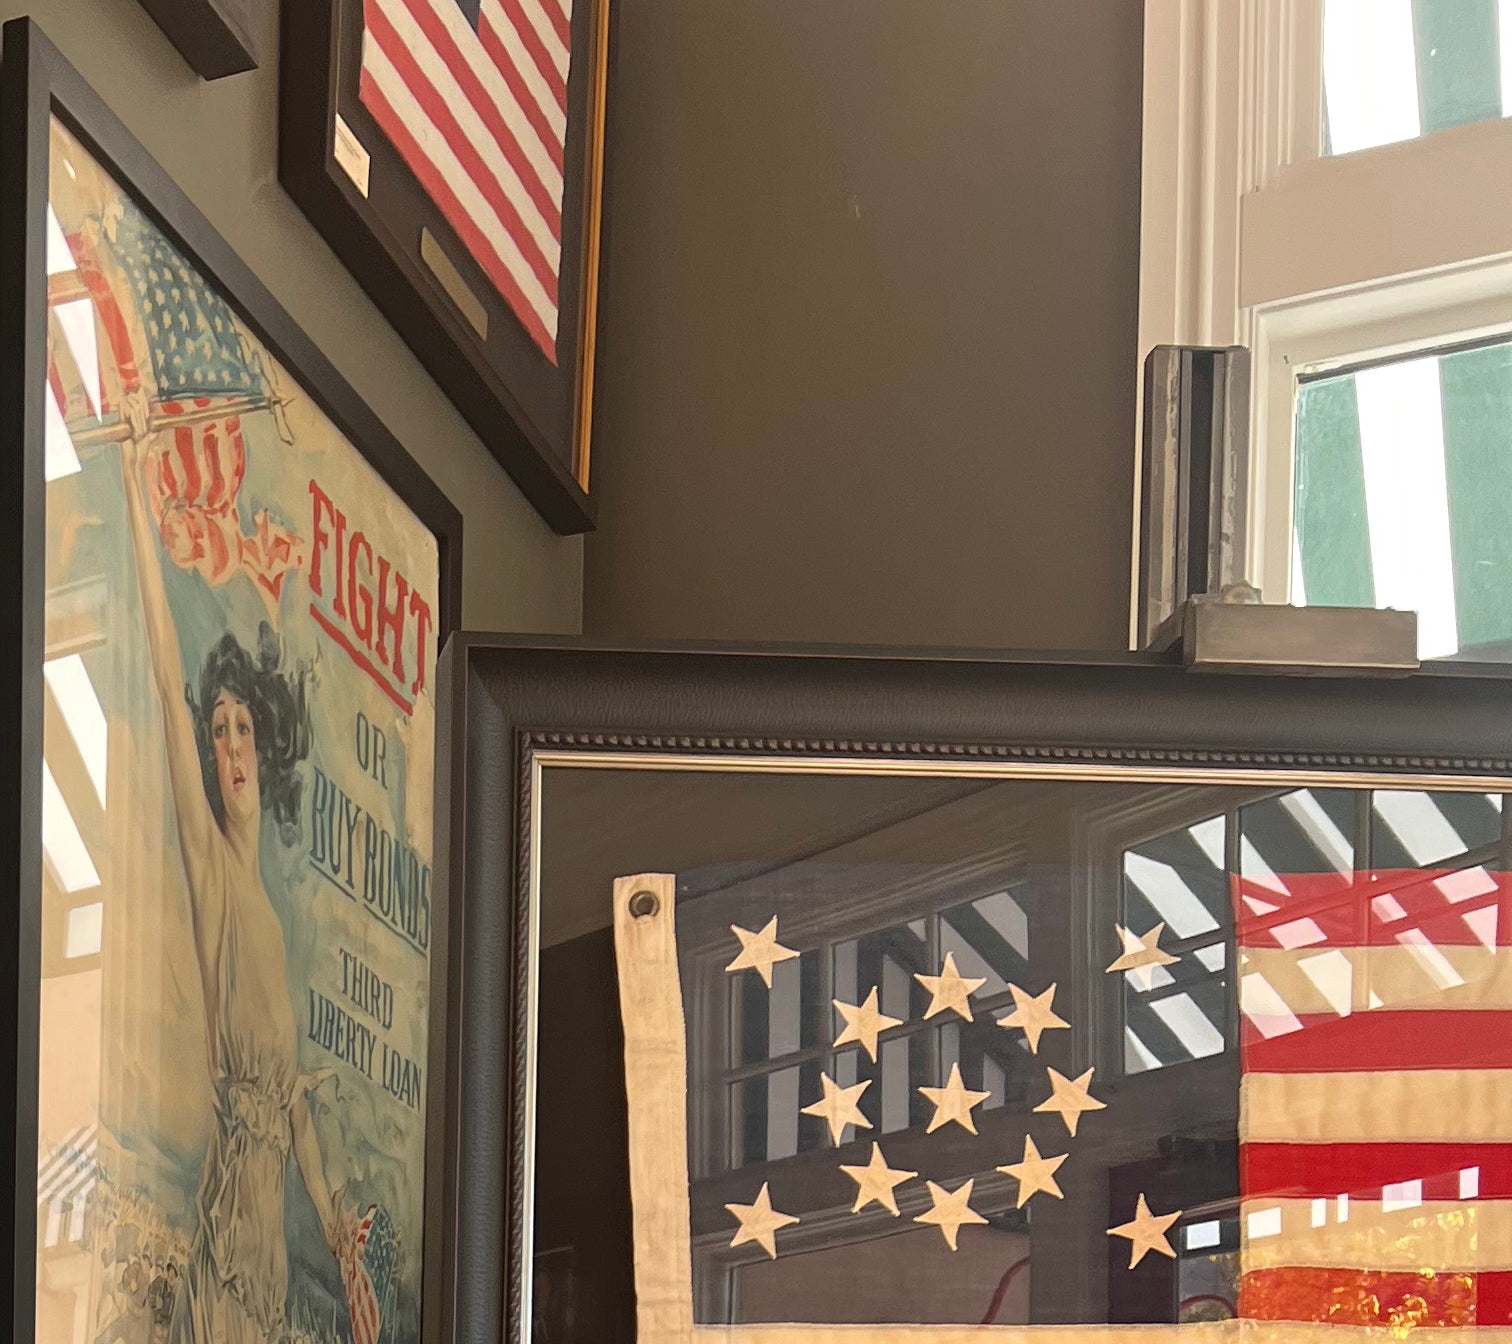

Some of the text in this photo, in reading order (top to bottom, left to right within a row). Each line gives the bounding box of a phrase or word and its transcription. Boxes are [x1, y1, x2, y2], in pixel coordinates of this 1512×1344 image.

[309, 478, 433, 697] FIGHT
[355, 709, 389, 791] OR
[309, 766, 432, 949] BUY BONDS
[307, 988, 422, 1112] LIBERTY LOAN
[339, 947, 395, 1031] THIRD
